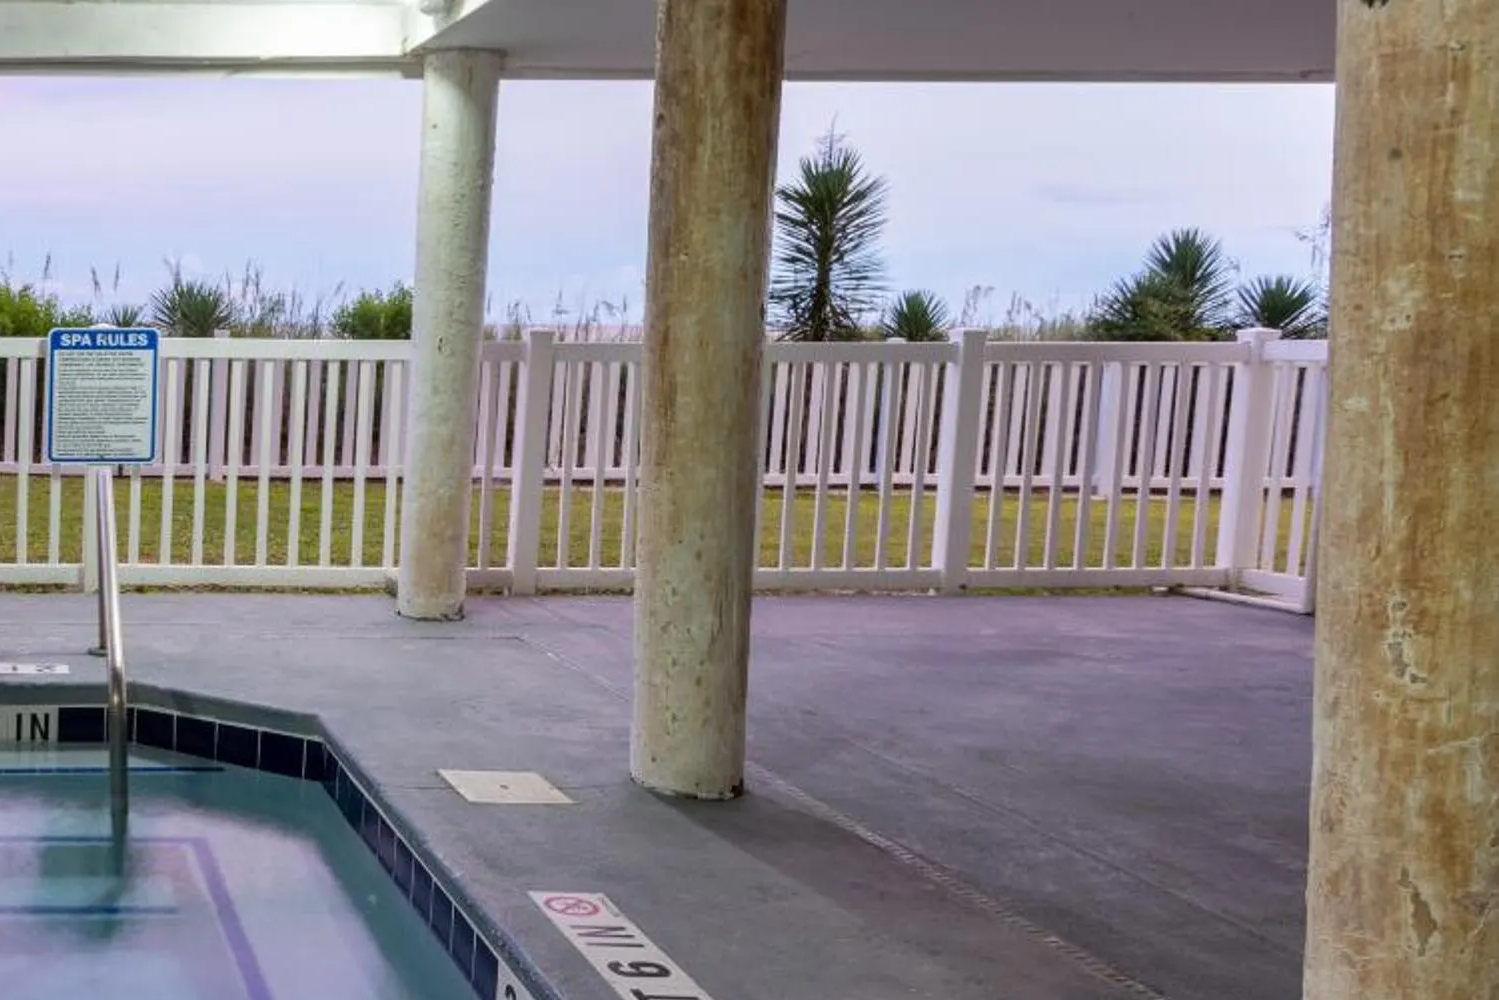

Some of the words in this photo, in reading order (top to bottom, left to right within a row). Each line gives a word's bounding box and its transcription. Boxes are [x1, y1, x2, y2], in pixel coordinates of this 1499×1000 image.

[60, 333, 93, 347] SPA
[96, 333, 149, 347] RULES
[15, 713, 50, 741] IN
[568, 923, 645, 949] IN
[606, 960, 671, 979] 6
